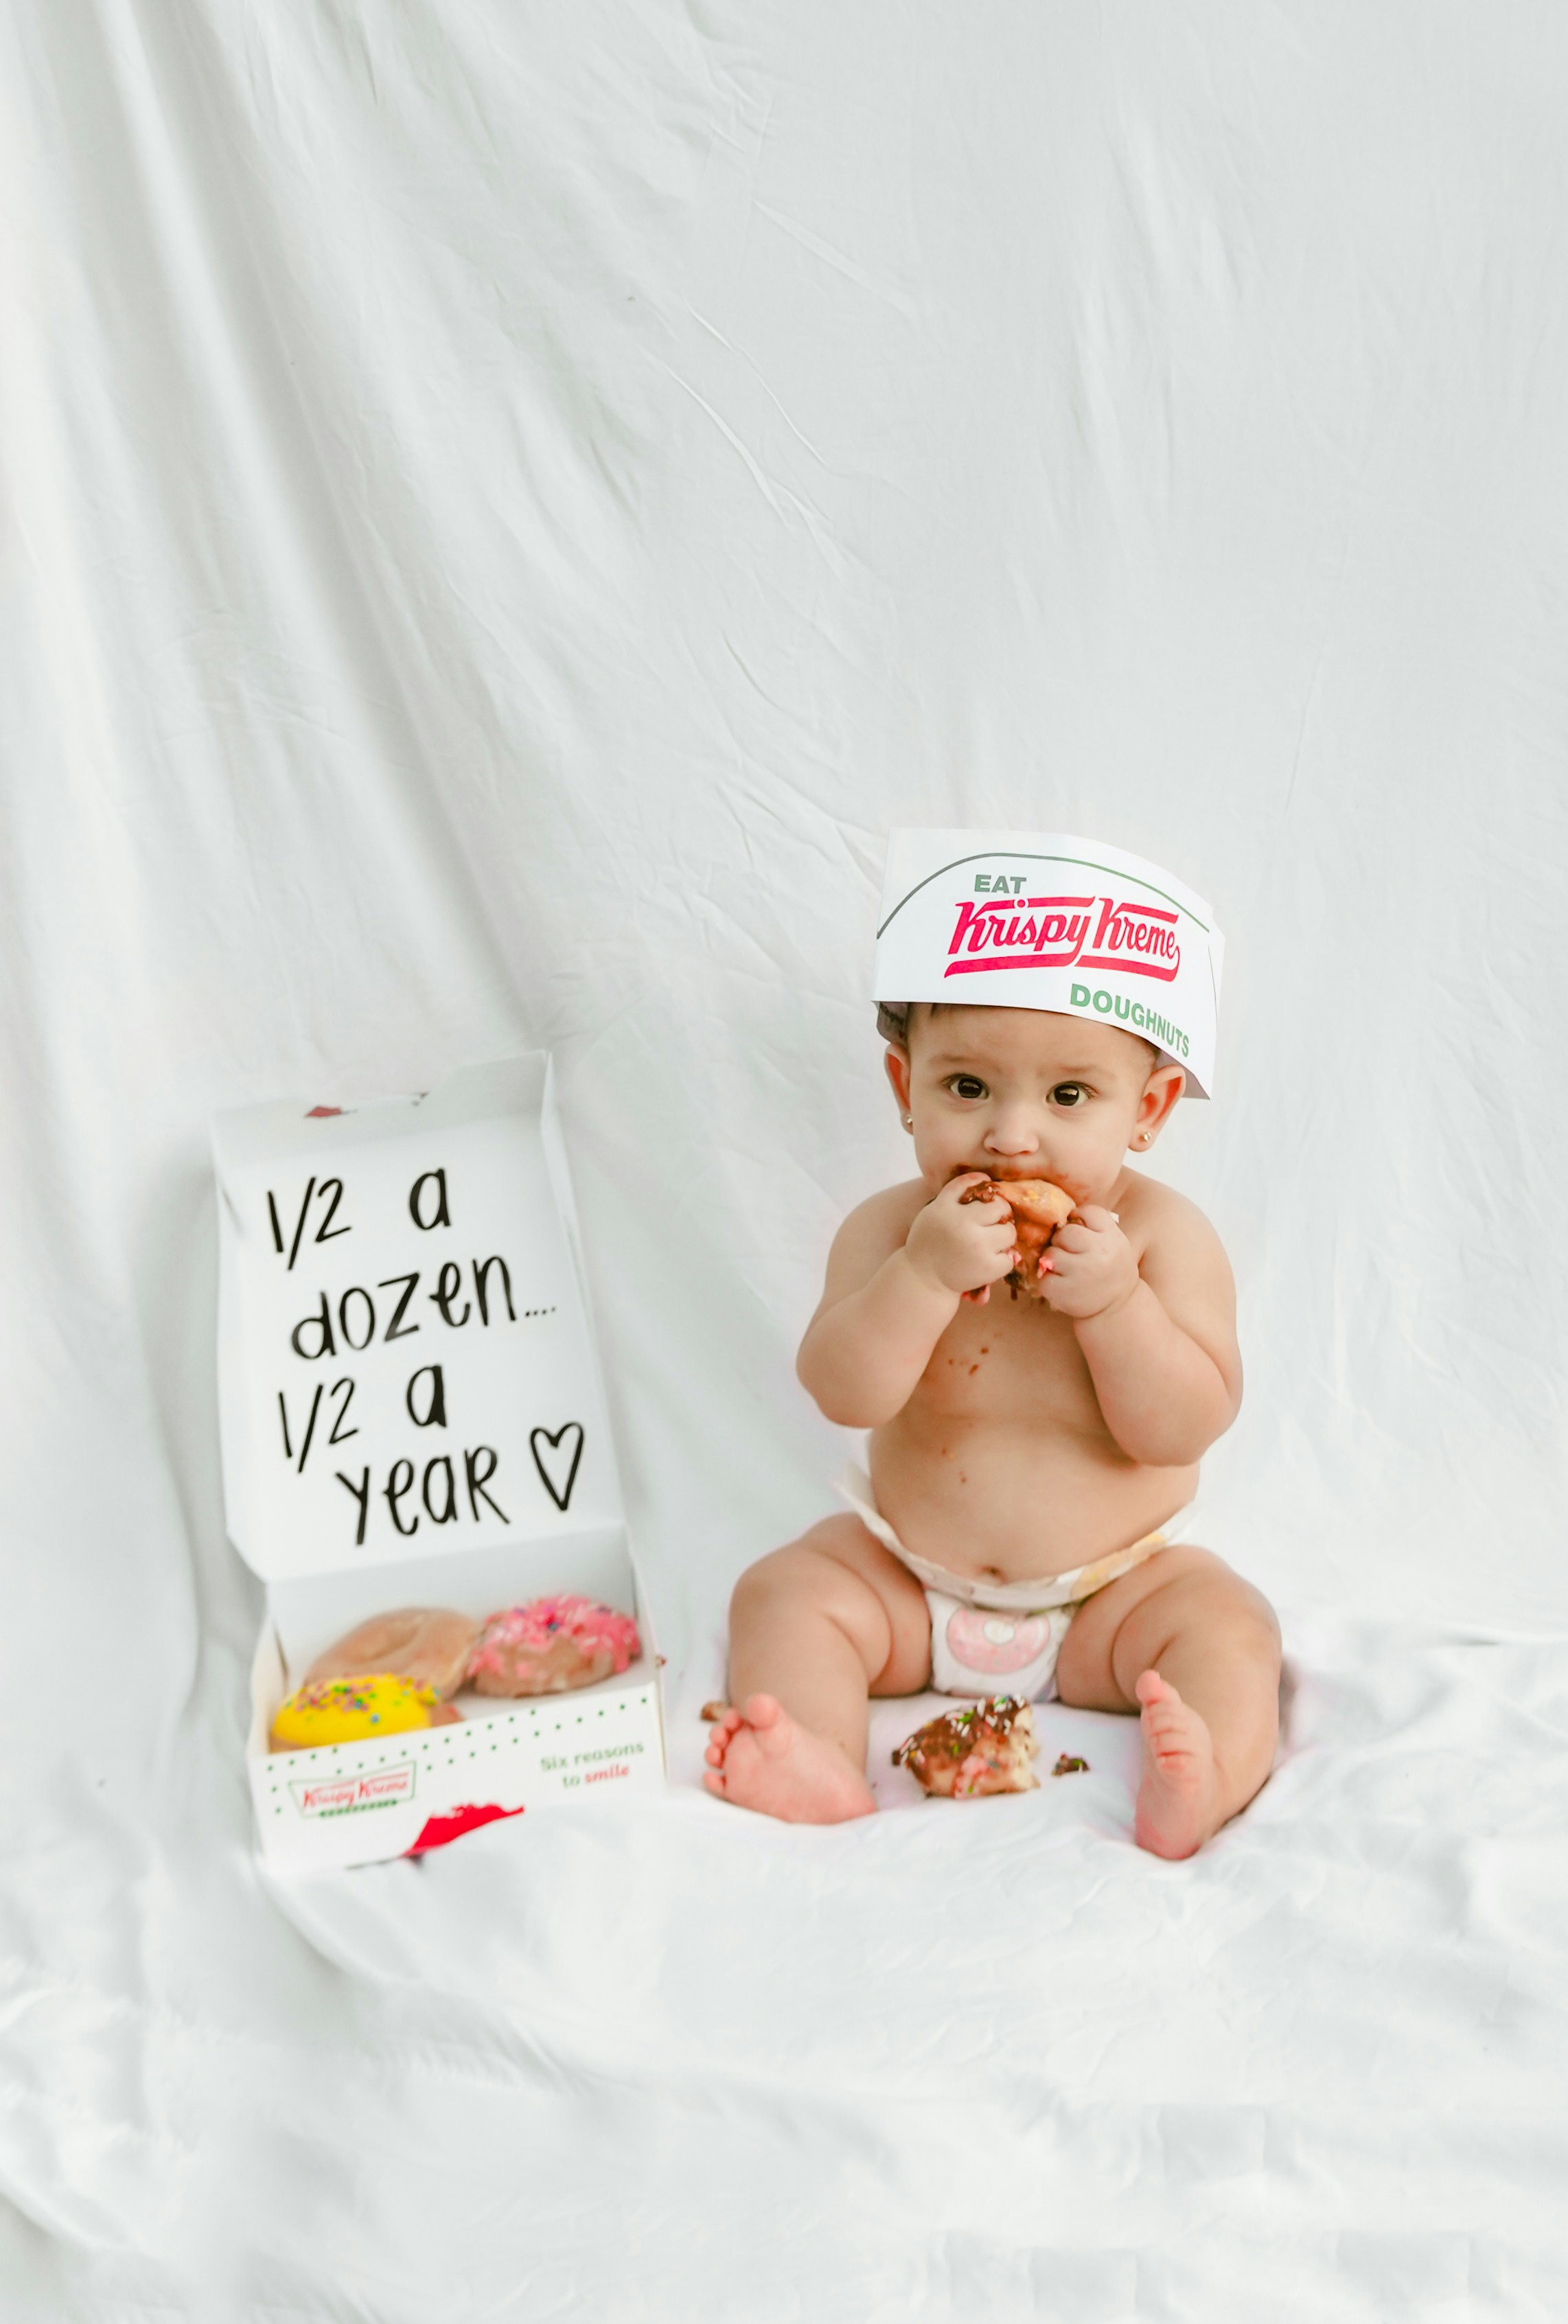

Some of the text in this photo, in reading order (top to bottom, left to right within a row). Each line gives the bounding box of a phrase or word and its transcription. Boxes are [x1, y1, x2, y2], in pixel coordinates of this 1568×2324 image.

[974, 874, 1027, 894] EAT
[944, 896, 1181, 982] Krispy Kreme
[1070, 983, 1190, 1058] DOUGHNUTS
[267, 1168, 451, 1271] 1/2 a
[278, 1364, 447, 1473] 1/2 a
[540, 1742, 645, 1771] Six reasons
[562, 1765, 629, 1788] to smile
